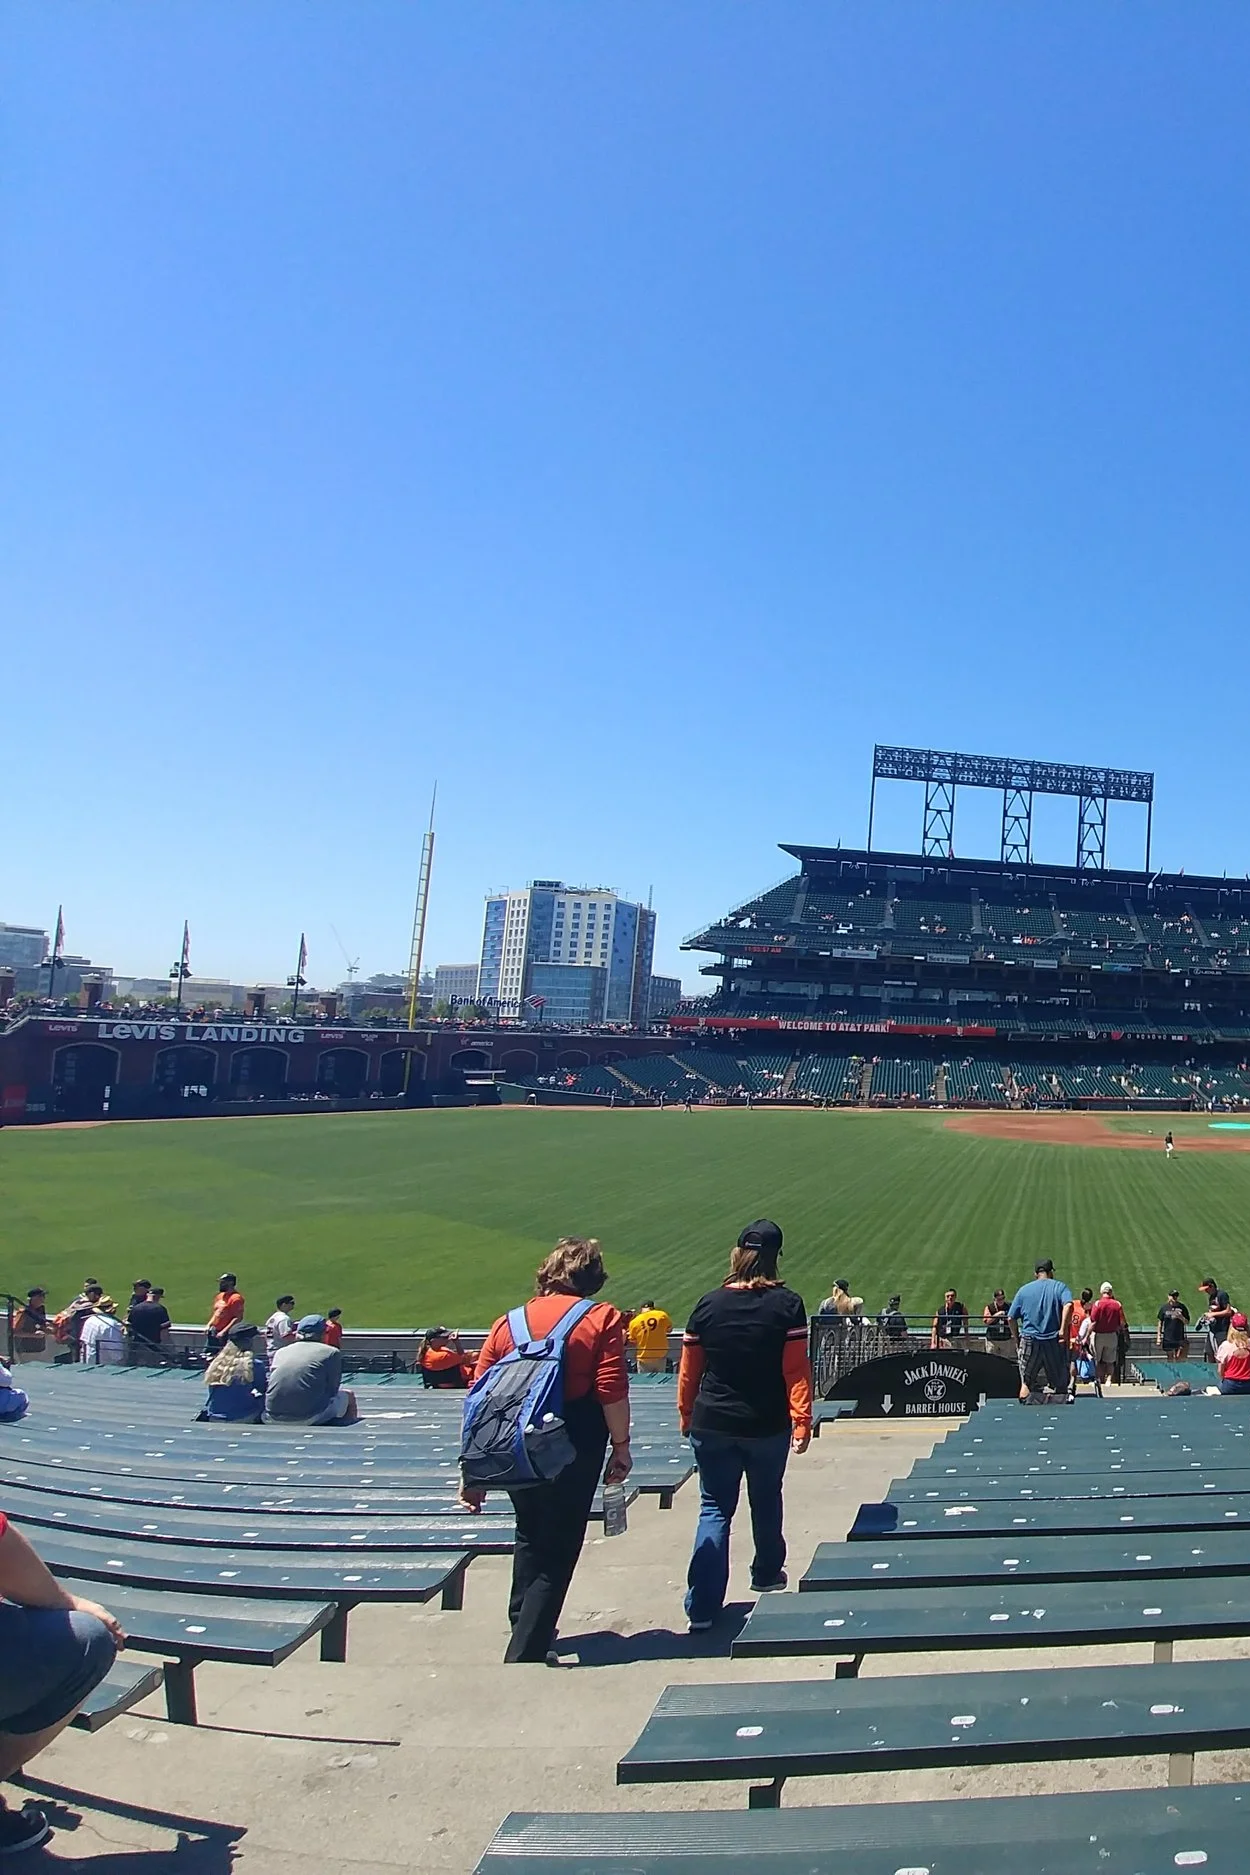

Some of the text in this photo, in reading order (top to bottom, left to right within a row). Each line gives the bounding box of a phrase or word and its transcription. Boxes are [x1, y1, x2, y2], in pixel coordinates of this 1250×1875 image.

[450, 993, 476, 1005] Bank
[477, 995, 486, 1006] of
[778, 1020, 890, 1033] WELCOME TO AT&T PARK!
[185, 1026, 305, 1043] LANDING
[905, 1402, 967, 1415] BARREL HOUSE
